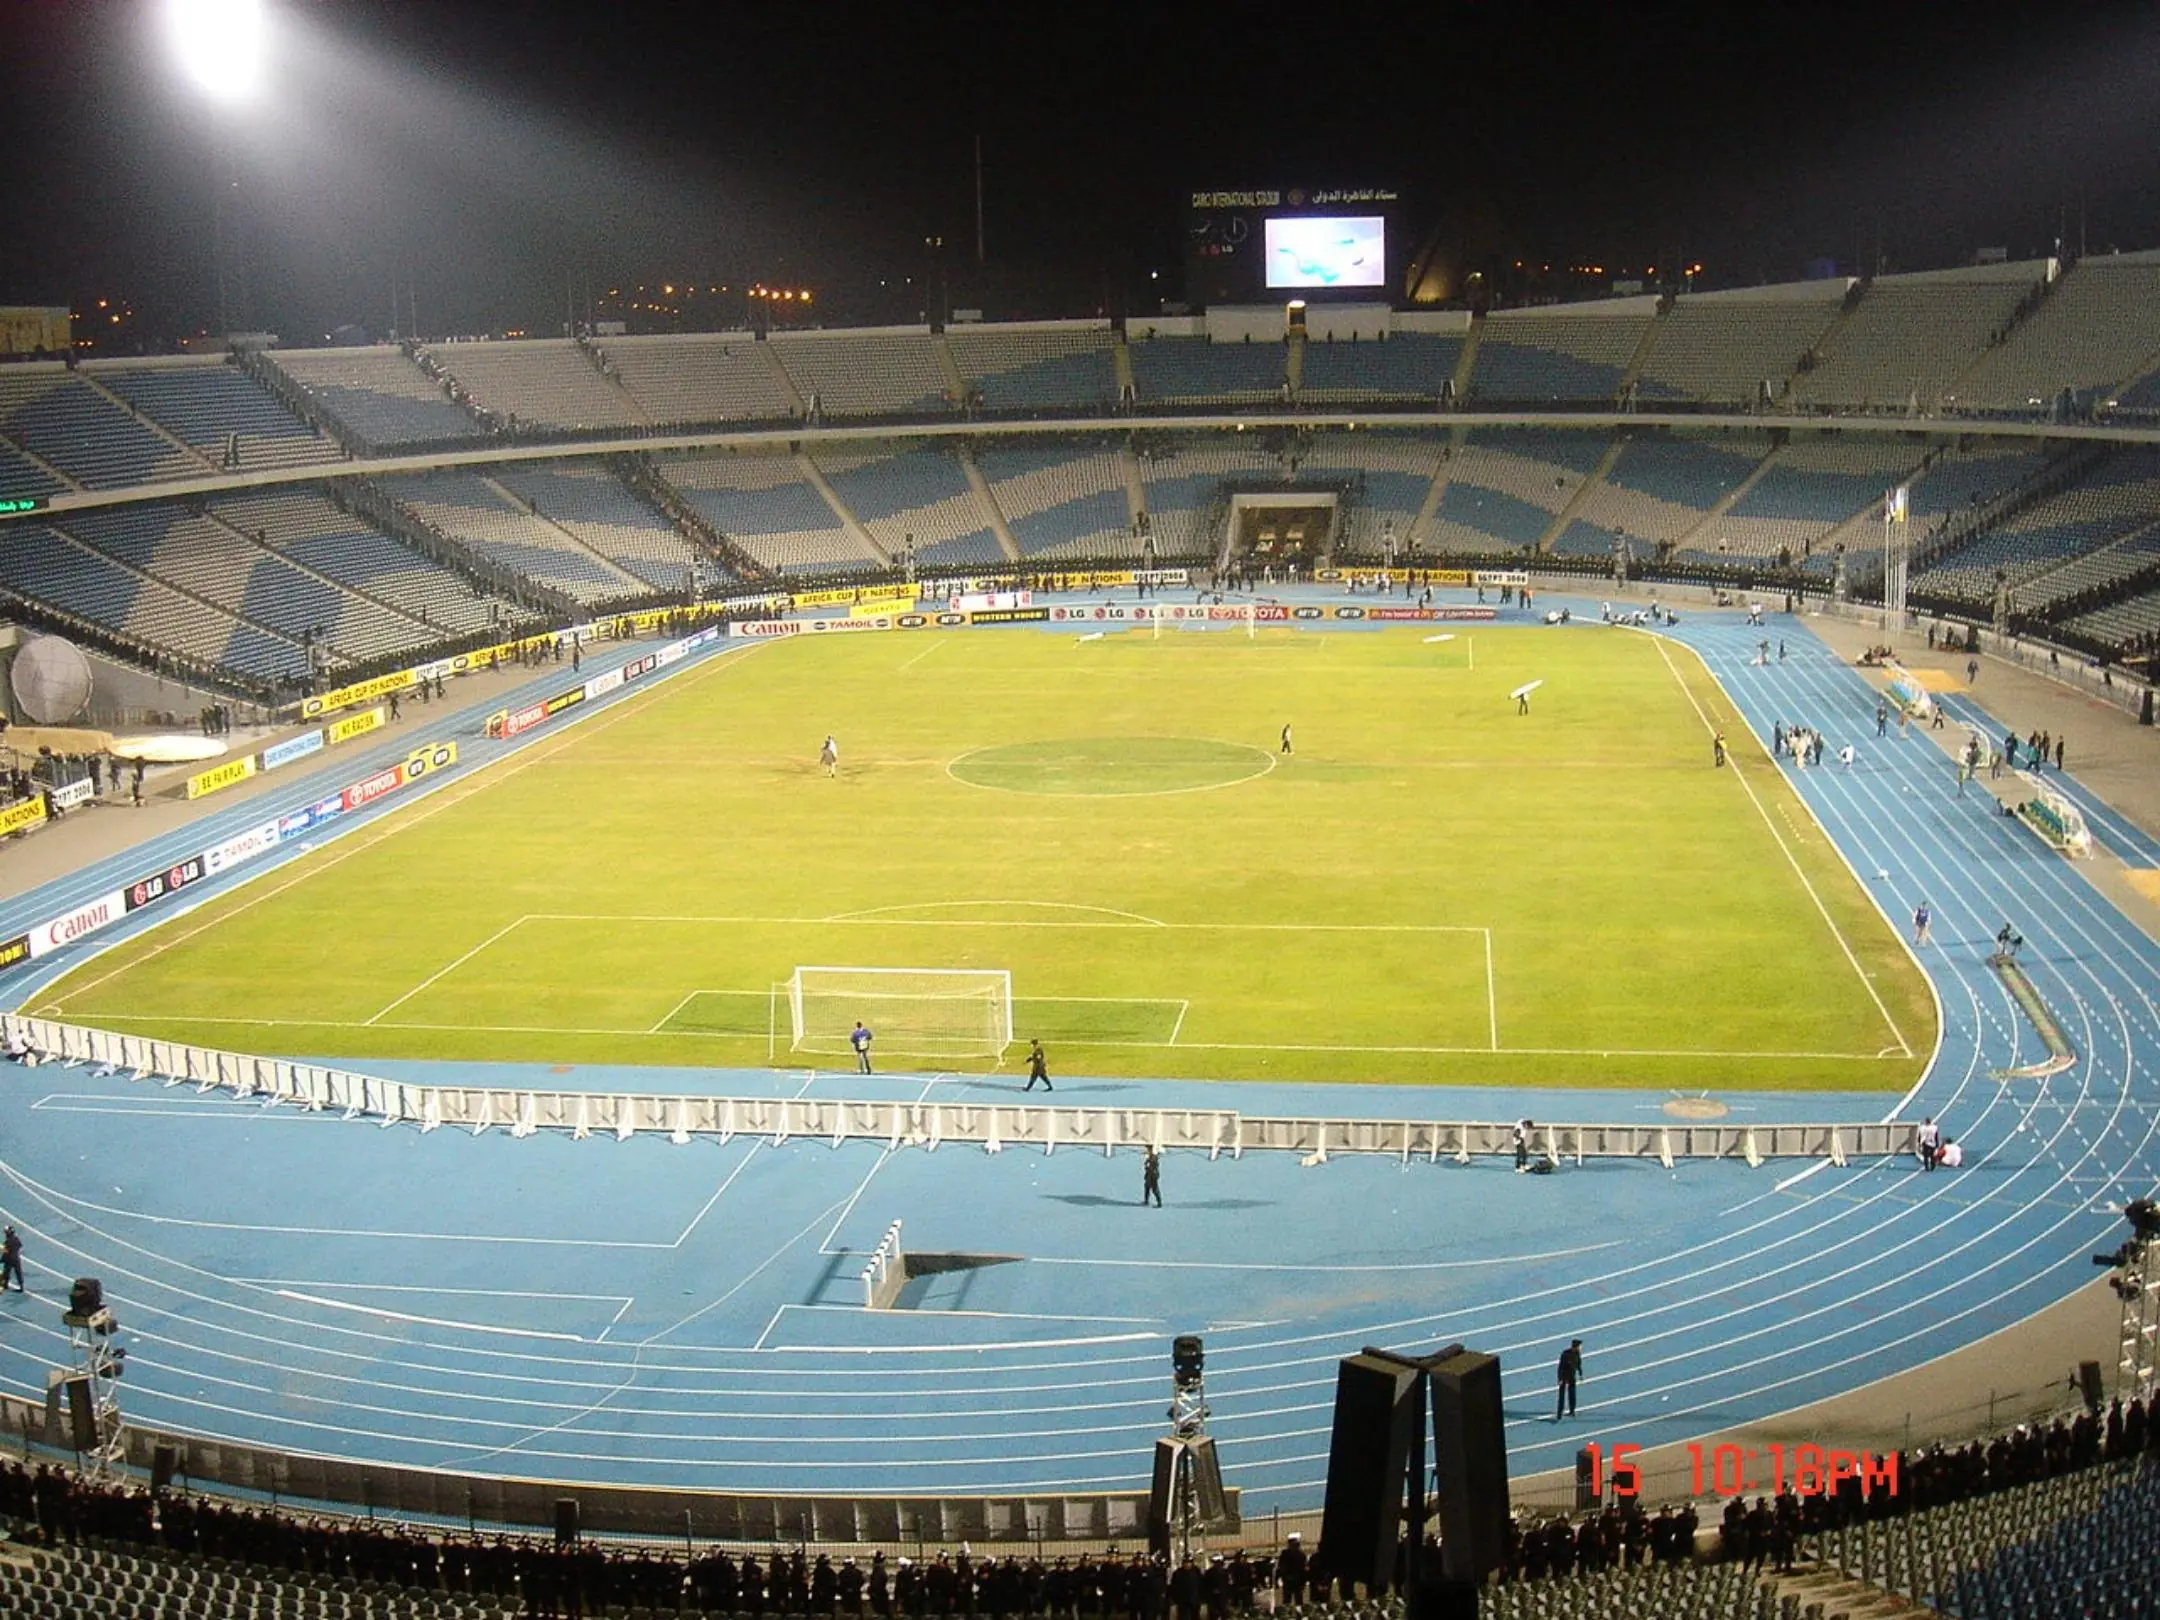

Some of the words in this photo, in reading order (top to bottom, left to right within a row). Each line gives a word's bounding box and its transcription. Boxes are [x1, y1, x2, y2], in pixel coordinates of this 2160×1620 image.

[803, 593, 832, 604] AFRICA
[1069, 608, 1085, 618] LG
[1109, 608, 1125, 618] LG
[1189, 608, 1204, 617] LG
[742, 622, 800, 635] Canon
[830, 619, 873, 629] TAMOIL
[183, 860, 199, 882] LG
[146, 876, 165, 896] LG
[50, 904, 109, 945] Canon
